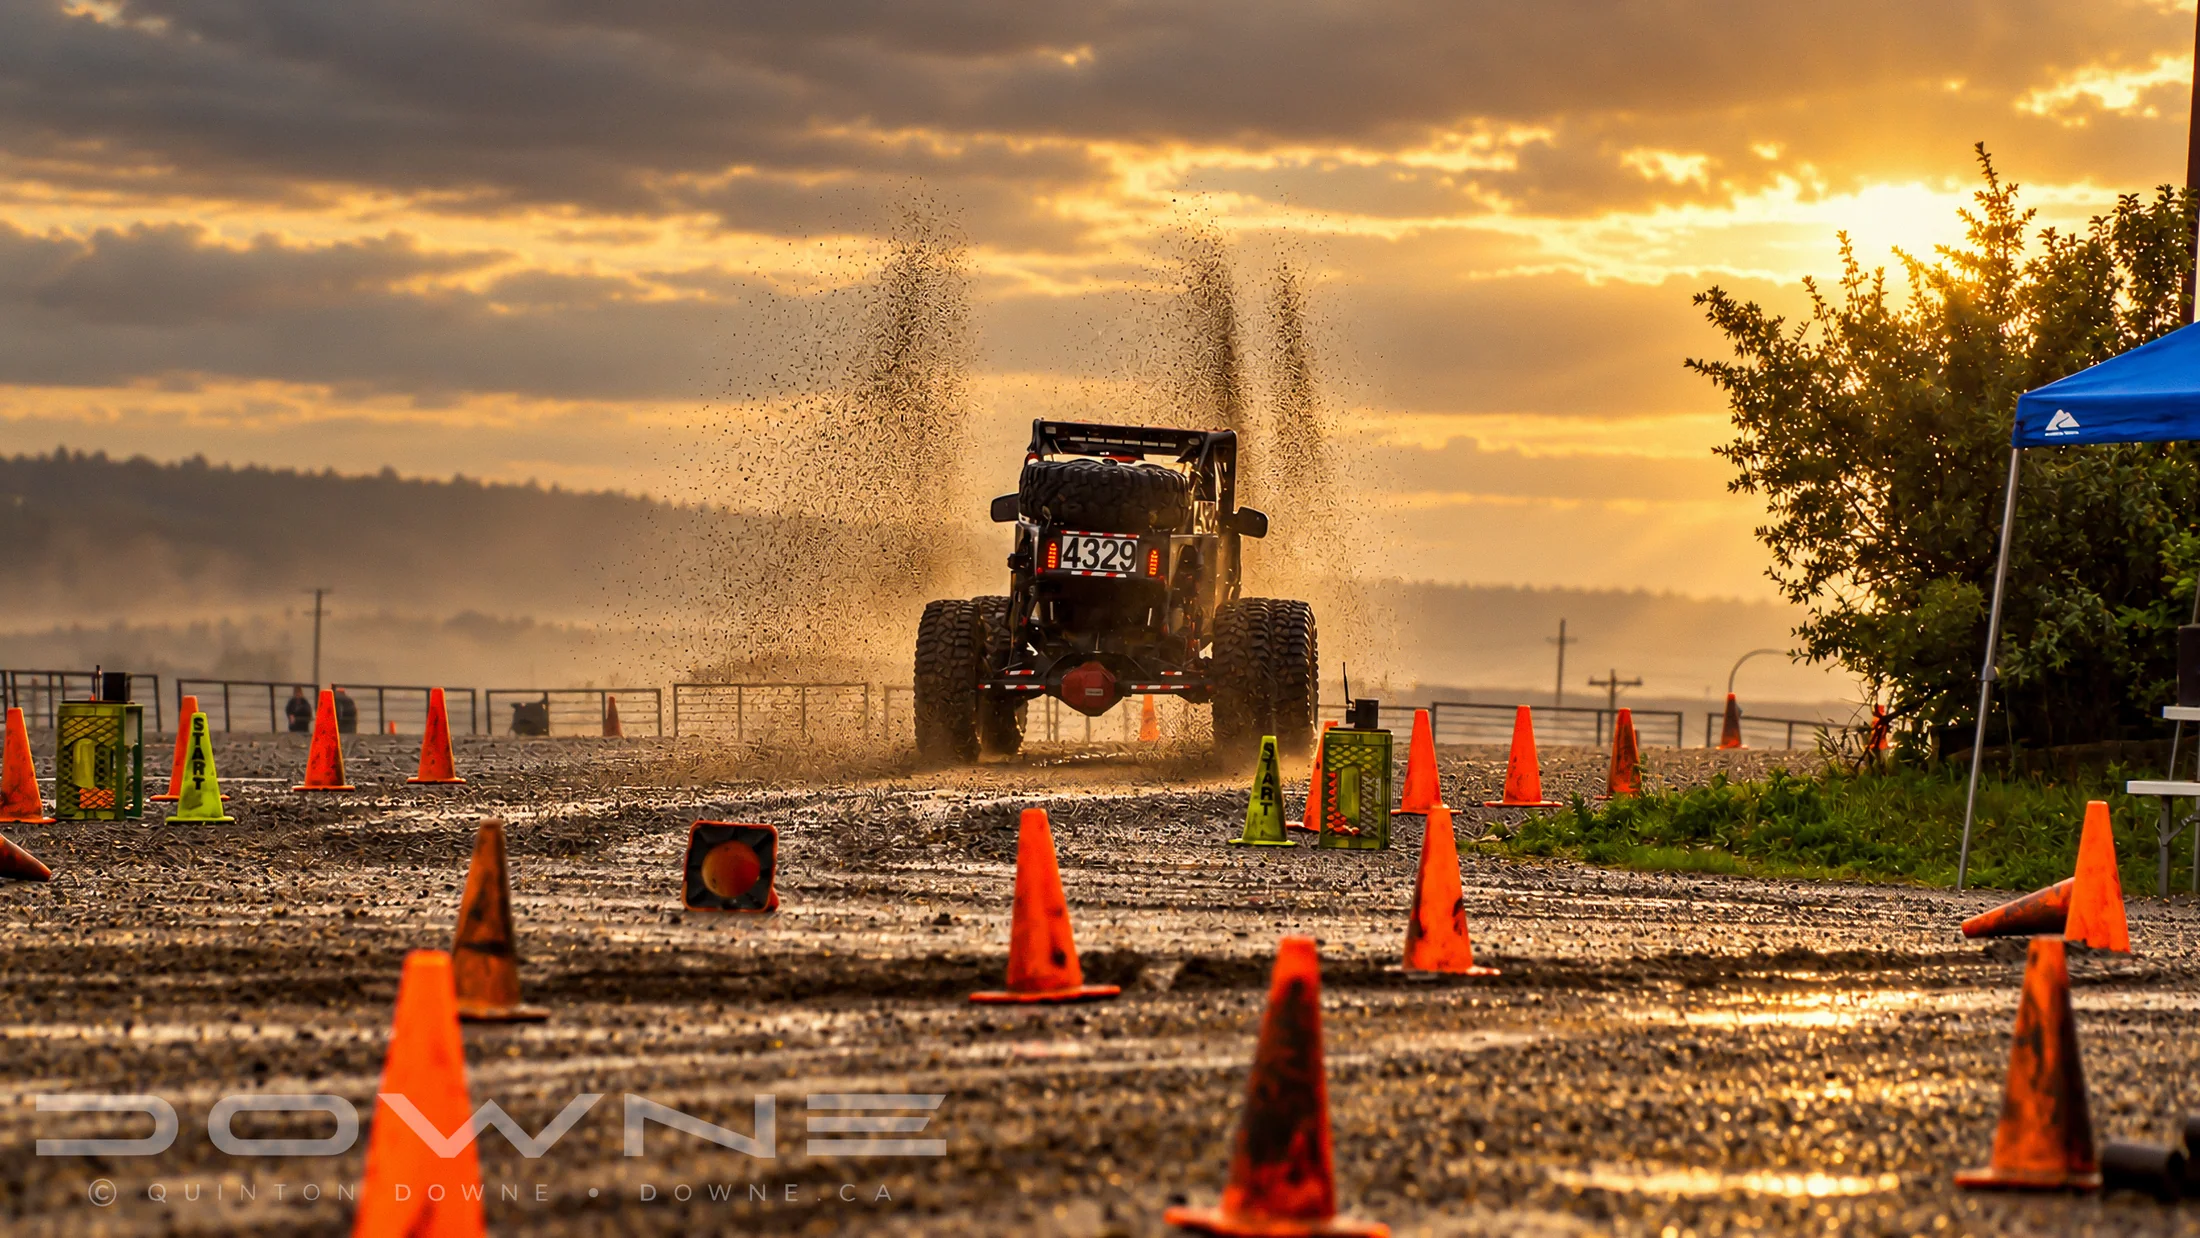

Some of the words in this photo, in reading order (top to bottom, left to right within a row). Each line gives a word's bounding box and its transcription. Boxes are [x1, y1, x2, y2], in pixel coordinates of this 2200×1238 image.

[1062, 538, 1136, 571] 4329
[192, 717, 206, 790] START
[1259, 742, 1275, 816] START
